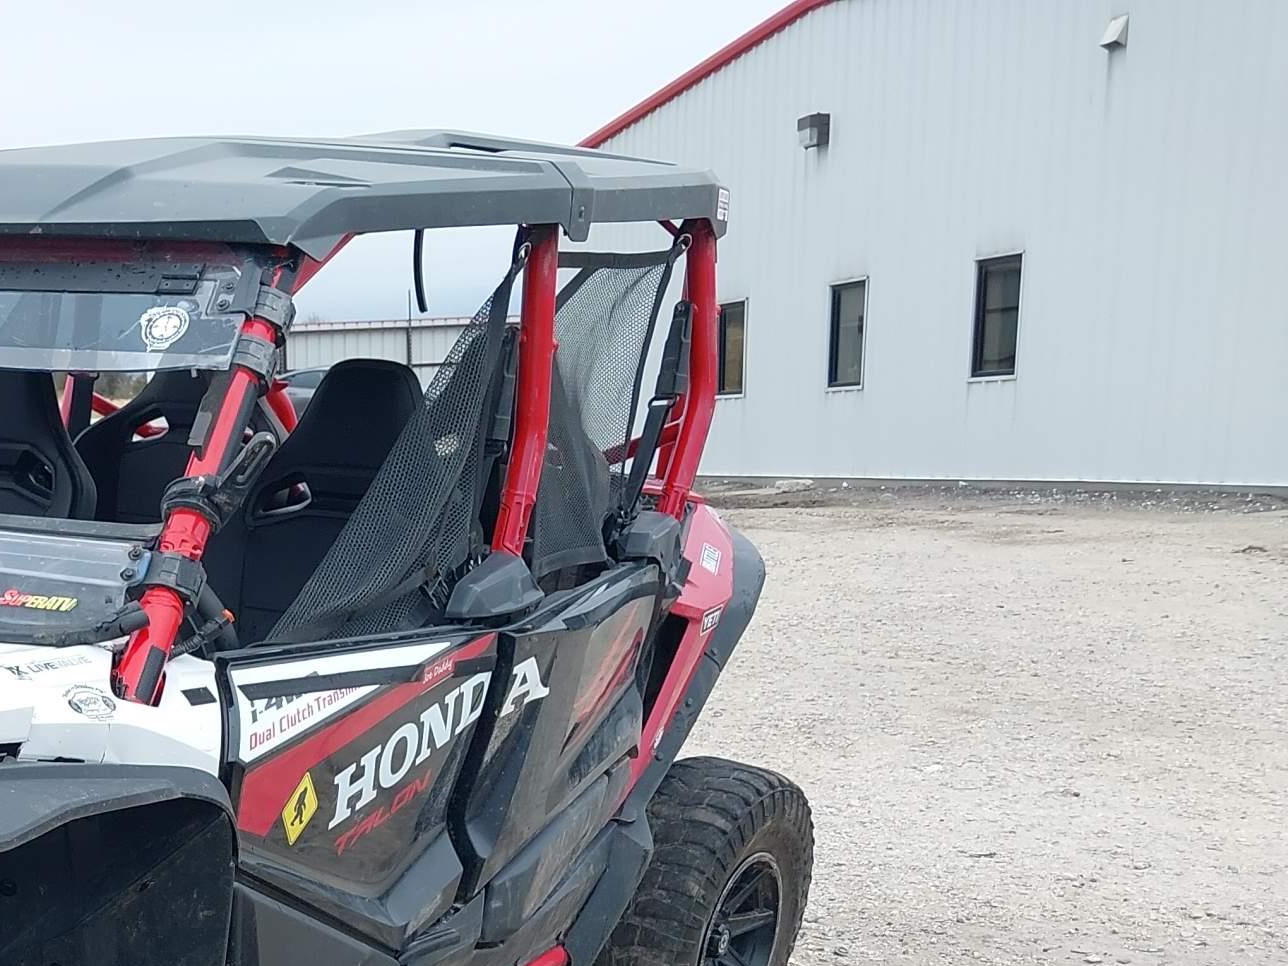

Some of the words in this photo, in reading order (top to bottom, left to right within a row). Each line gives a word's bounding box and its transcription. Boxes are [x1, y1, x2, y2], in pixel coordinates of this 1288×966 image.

[249, 721, 277, 752] Dual
[279, 702, 314, 734] Clutch
[327, 655, 551, 832] HONDA
